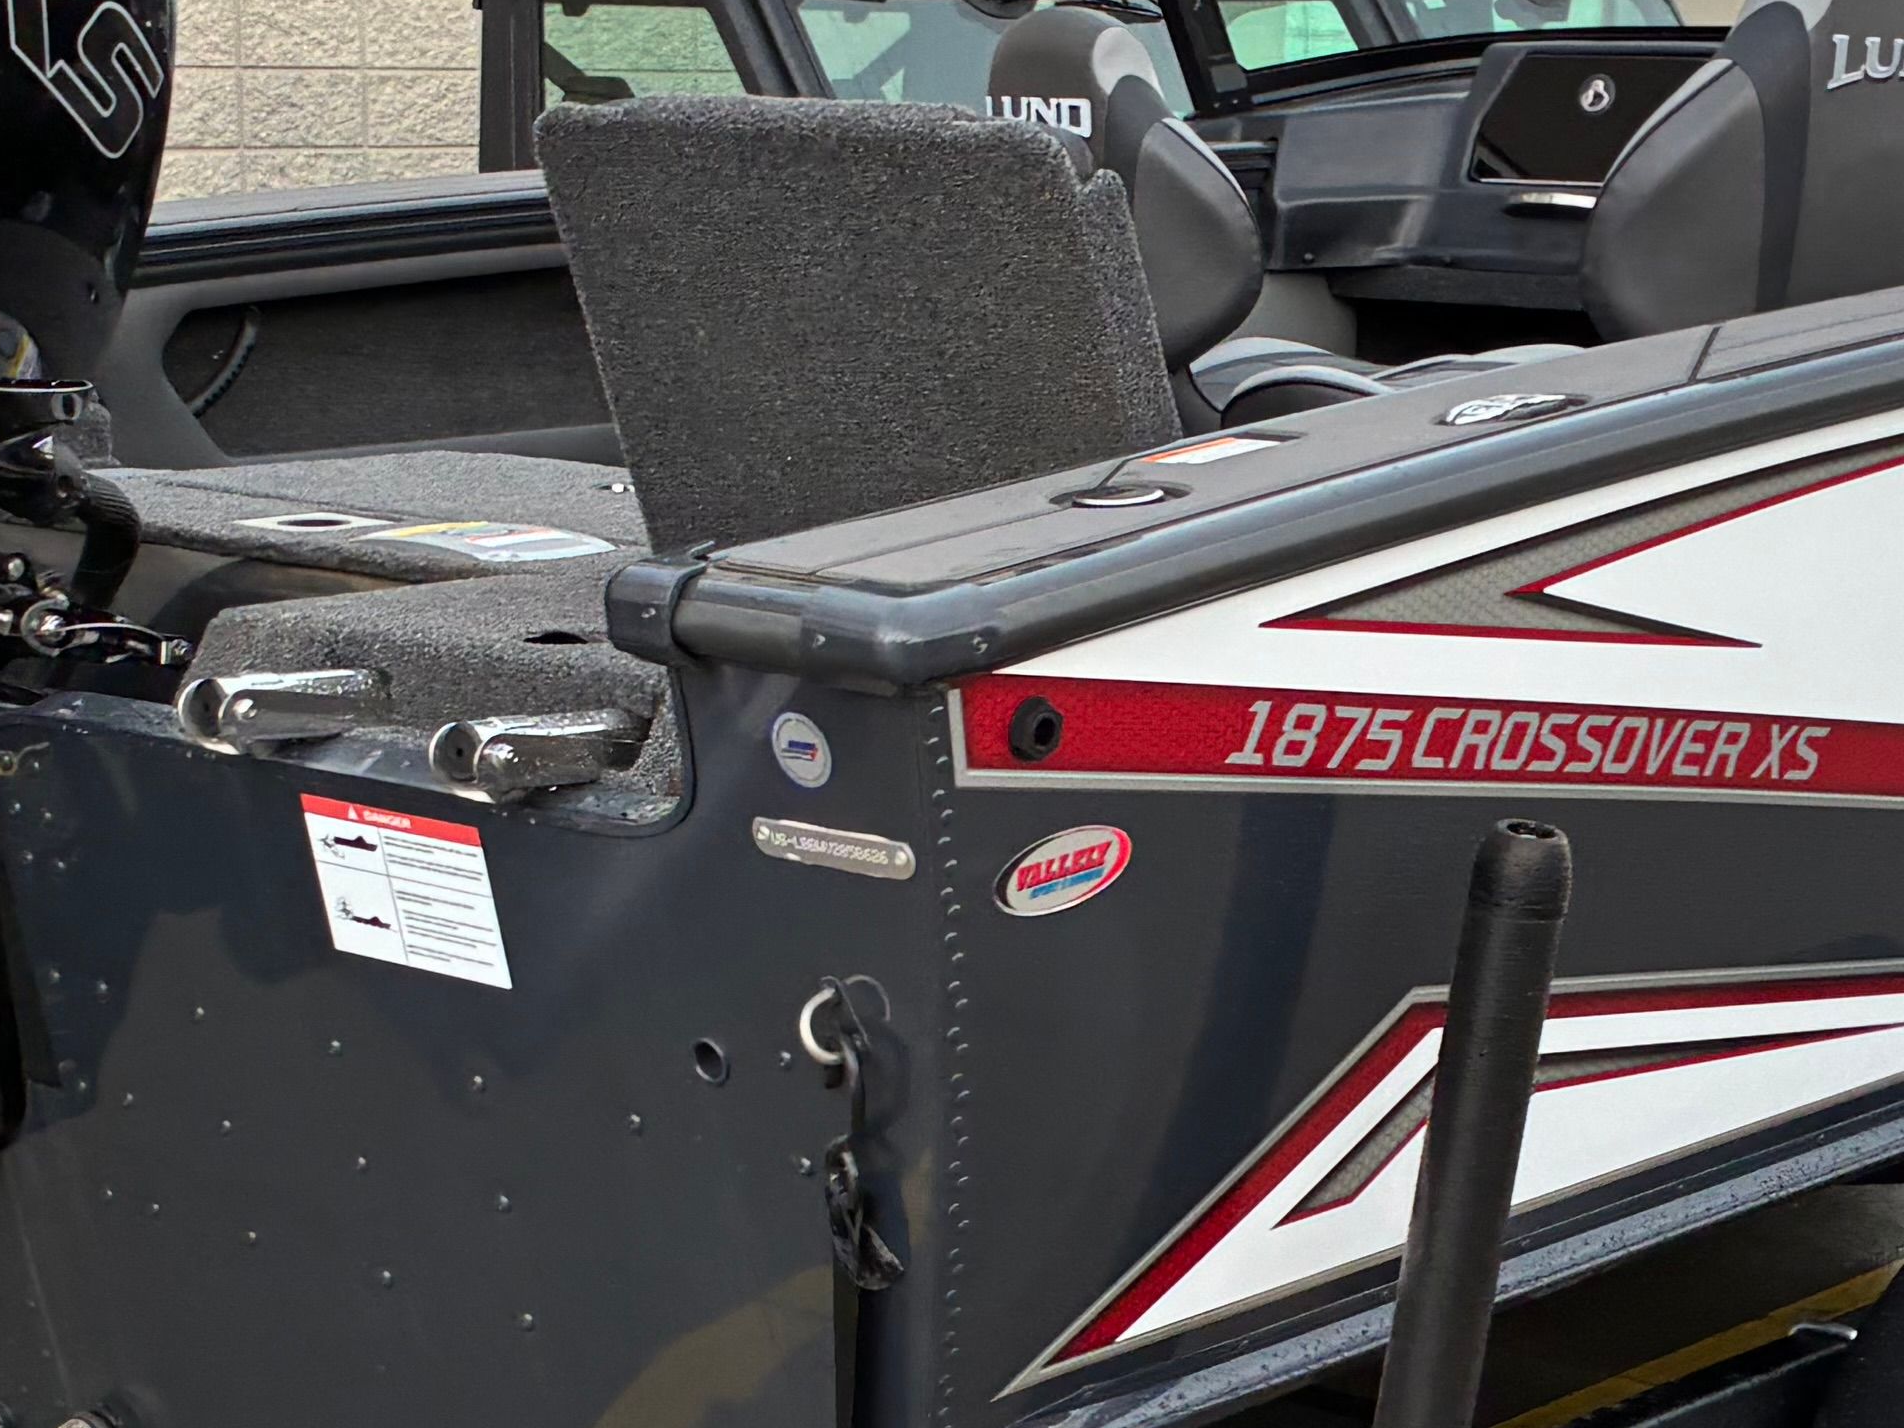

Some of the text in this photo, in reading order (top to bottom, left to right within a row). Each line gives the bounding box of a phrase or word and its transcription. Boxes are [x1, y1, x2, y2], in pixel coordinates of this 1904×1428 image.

[1226, 700, 1831, 781] 1875 CROSSOVER XS
